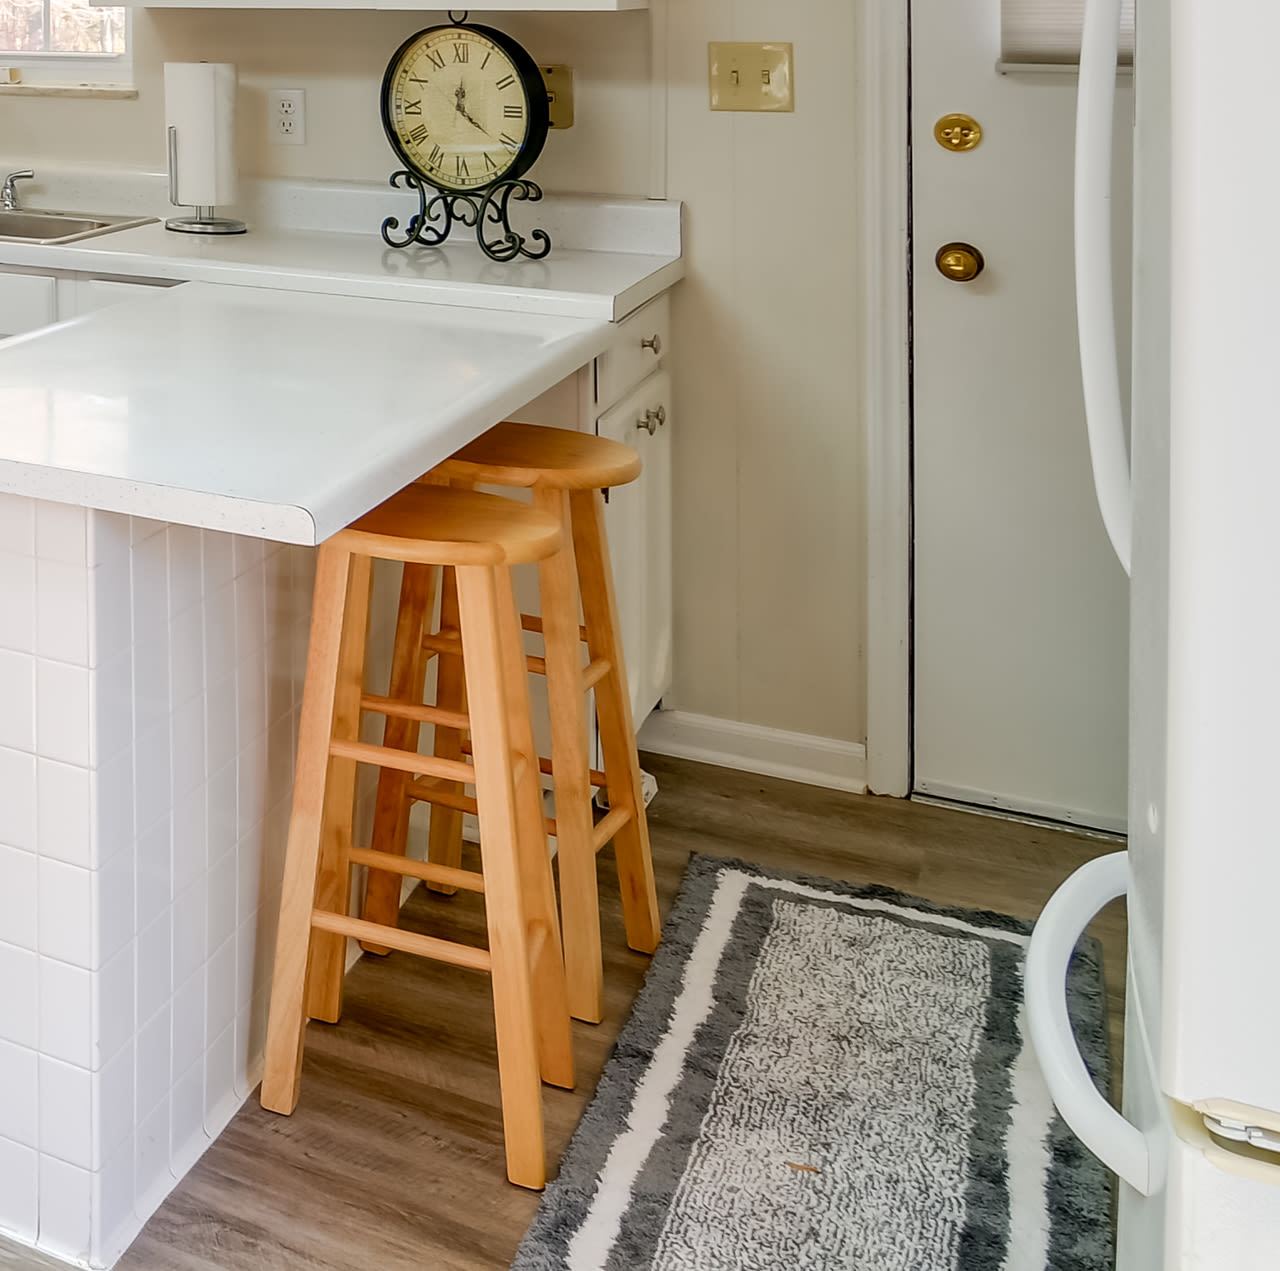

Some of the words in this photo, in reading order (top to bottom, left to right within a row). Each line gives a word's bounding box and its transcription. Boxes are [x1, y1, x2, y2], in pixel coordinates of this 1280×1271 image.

[426, 49, 446, 71] XI
[453, 43, 469, 63] XII
[409, 72, 428, 90] X
[496, 74, 515, 90] II
